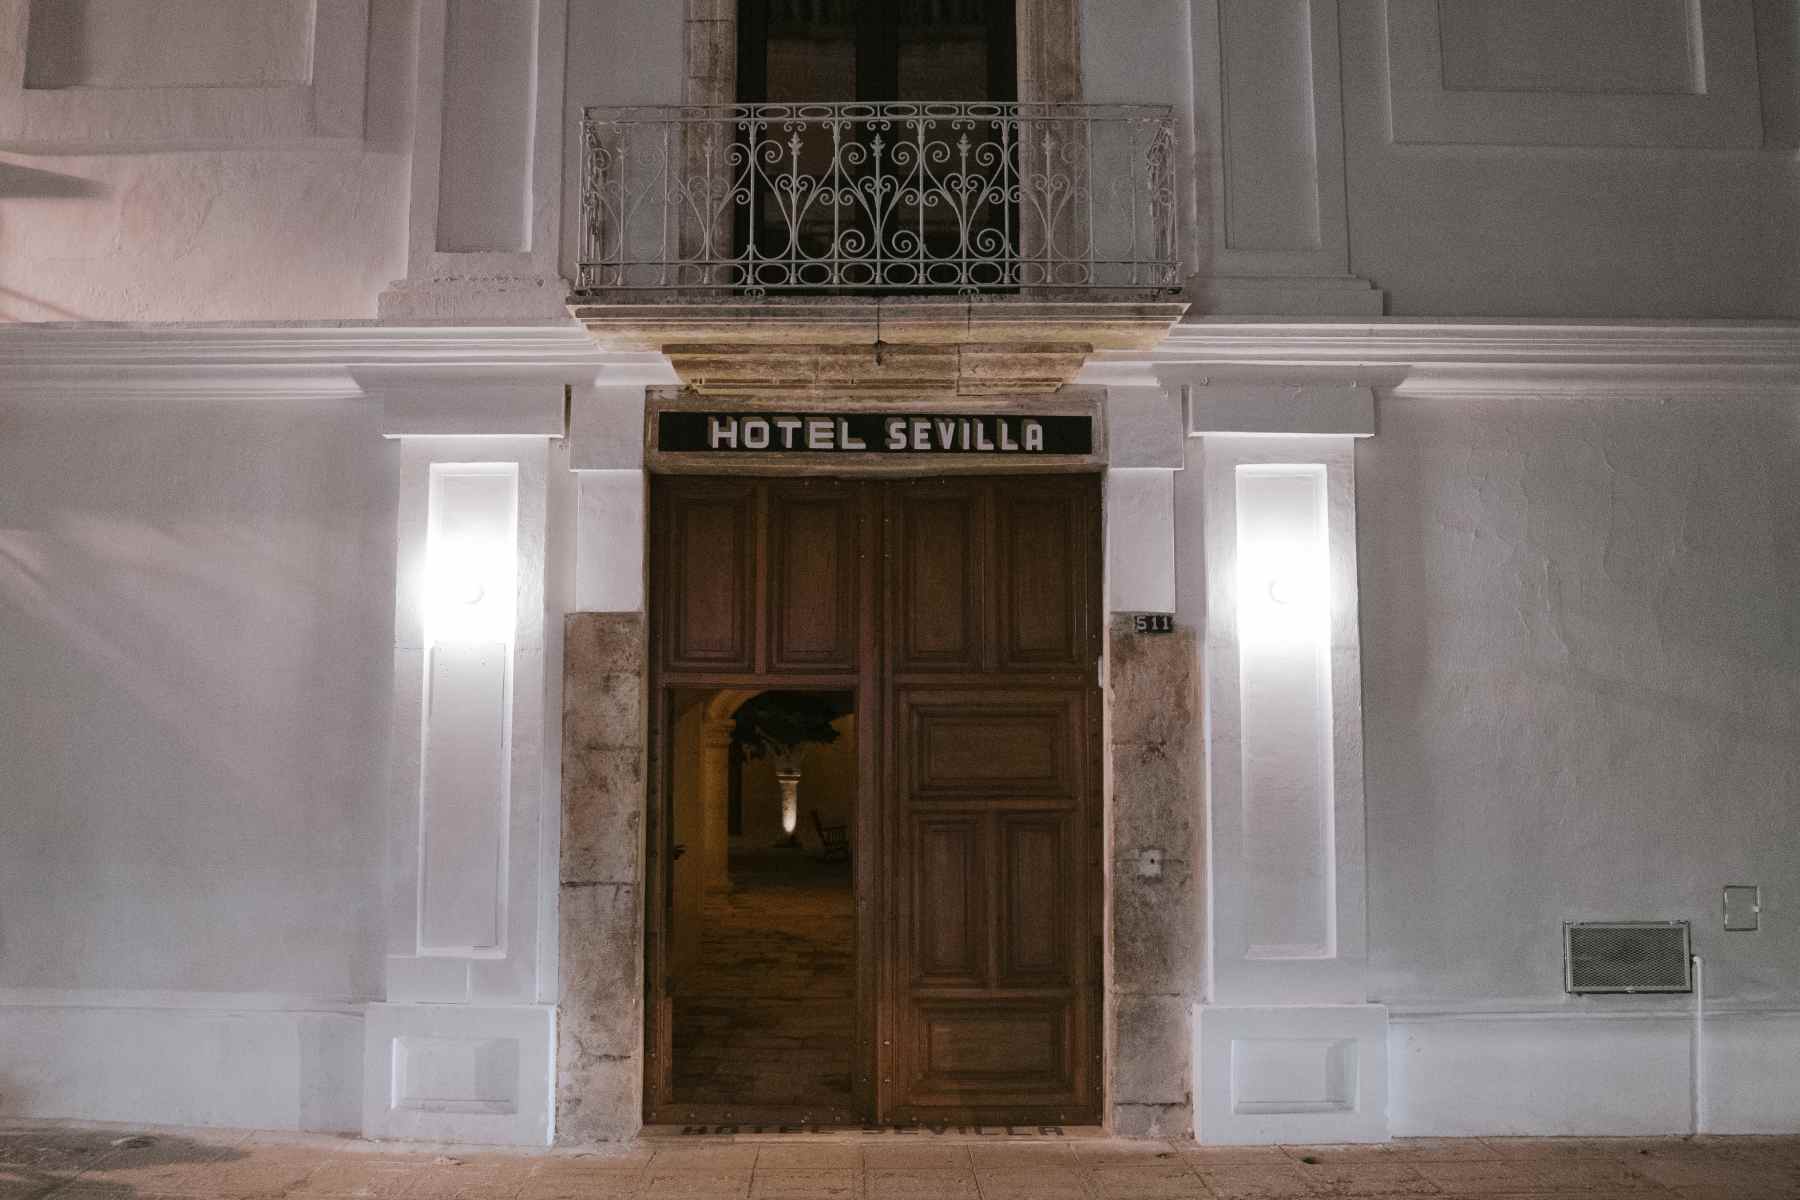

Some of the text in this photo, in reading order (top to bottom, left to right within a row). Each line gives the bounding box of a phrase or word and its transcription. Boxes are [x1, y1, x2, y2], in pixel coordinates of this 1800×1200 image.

[709, 419, 1044, 451] HOTEL SEVILLA
[1136, 615, 1169, 630] 511
